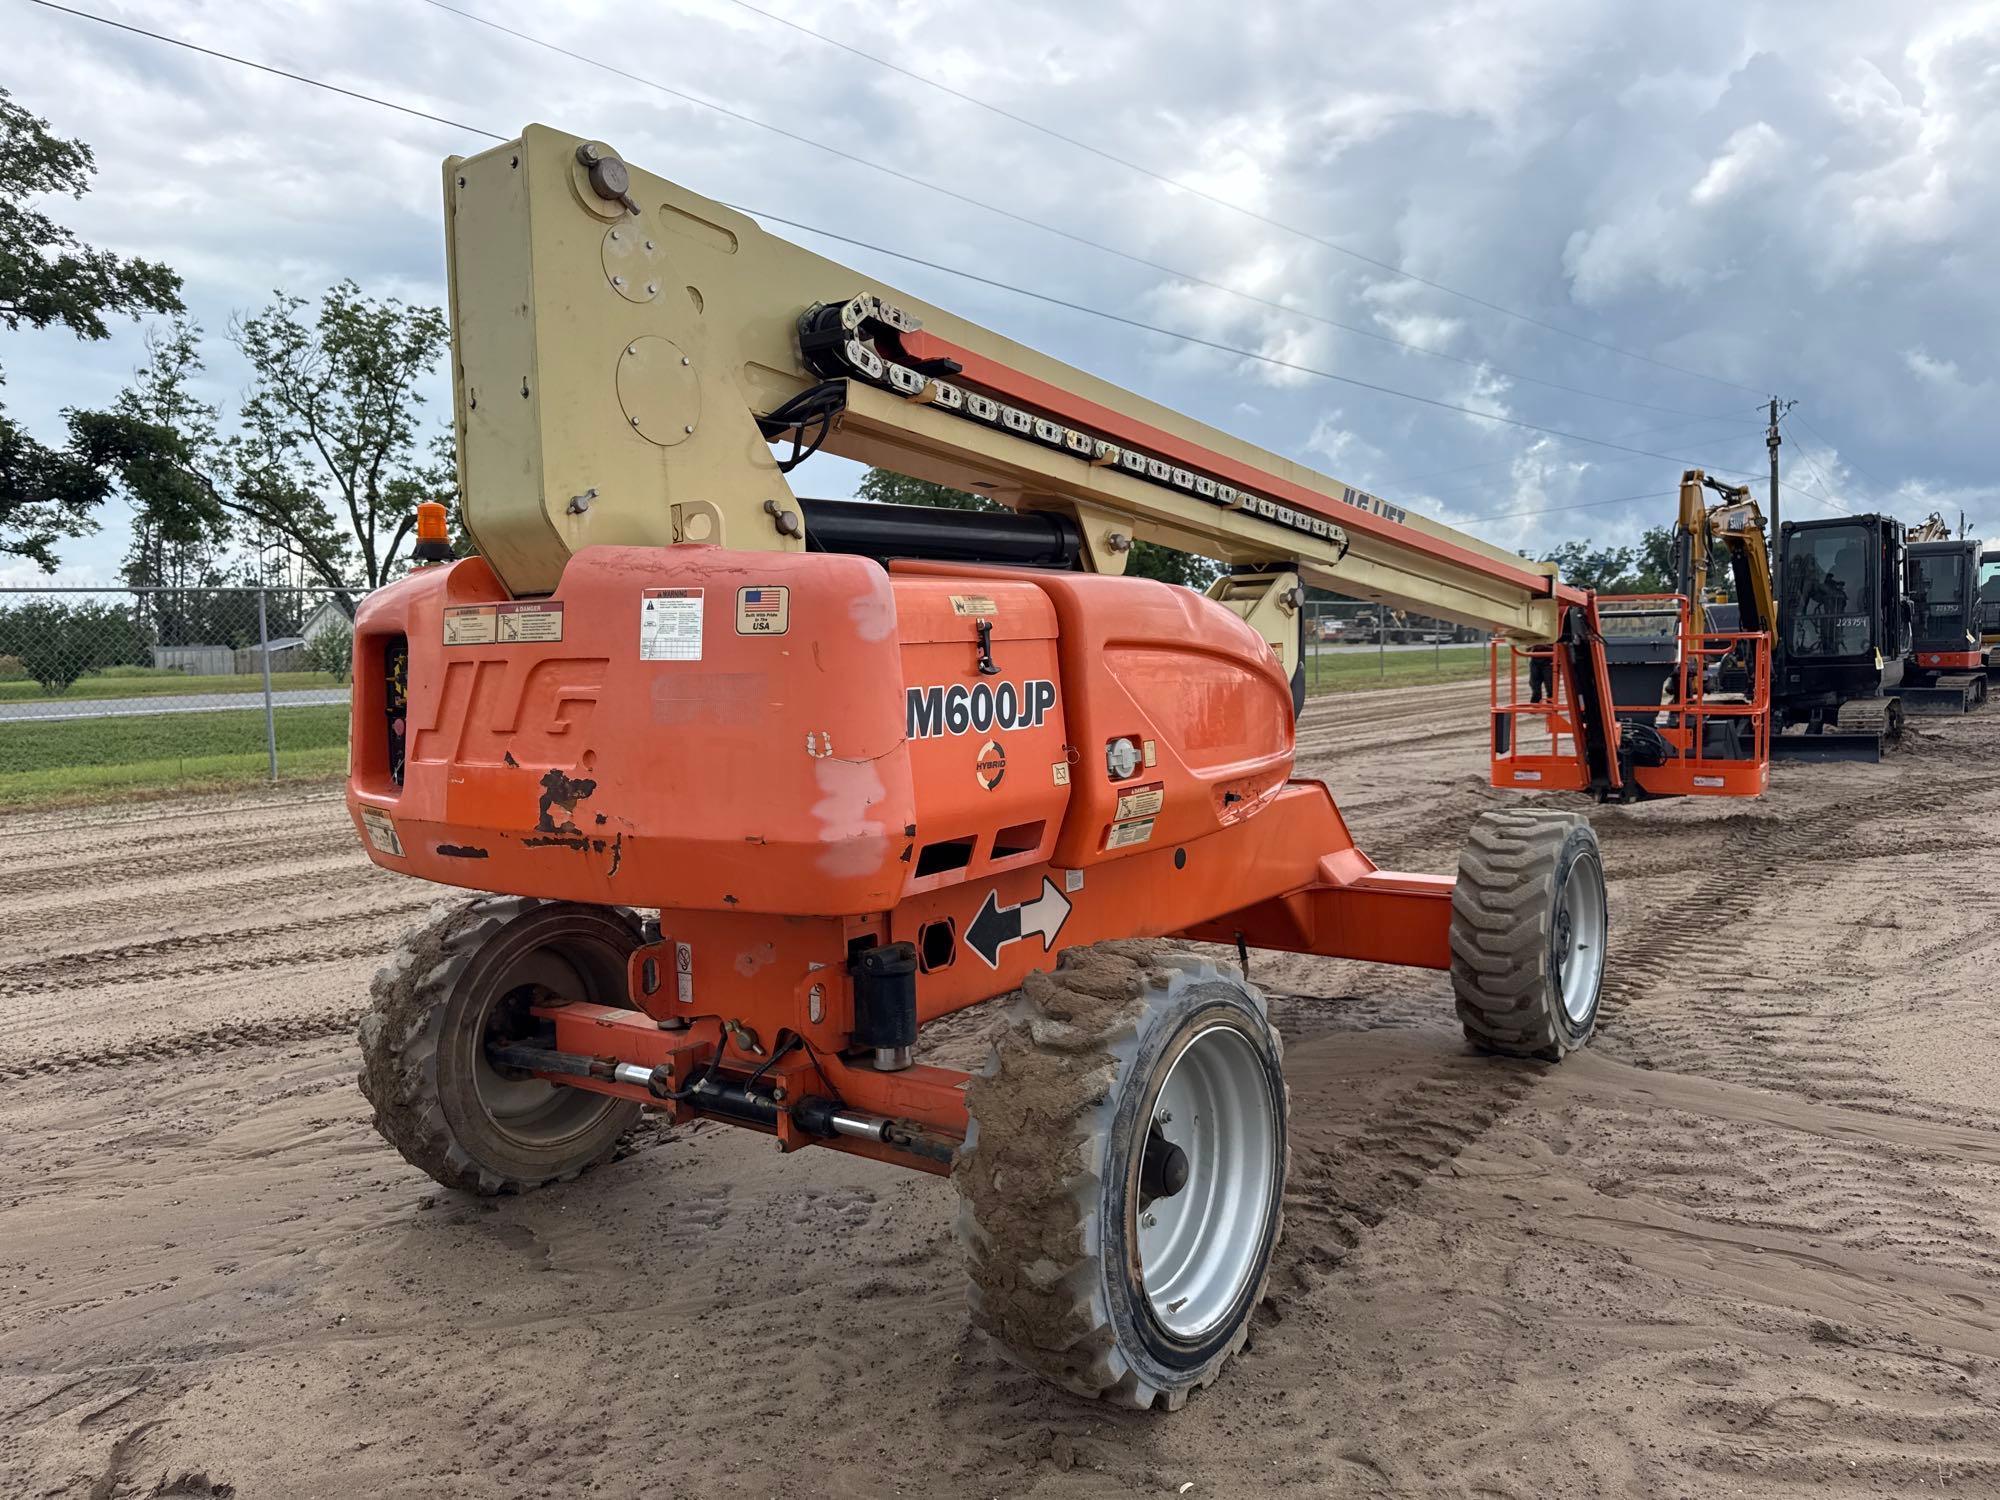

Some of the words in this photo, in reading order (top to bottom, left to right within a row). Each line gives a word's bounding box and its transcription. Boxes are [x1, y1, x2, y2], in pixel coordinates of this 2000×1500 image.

[411, 657, 611, 770] JLG
[906, 680, 1056, 740] M600JP
[976, 759, 1006, 771] HYBRID
